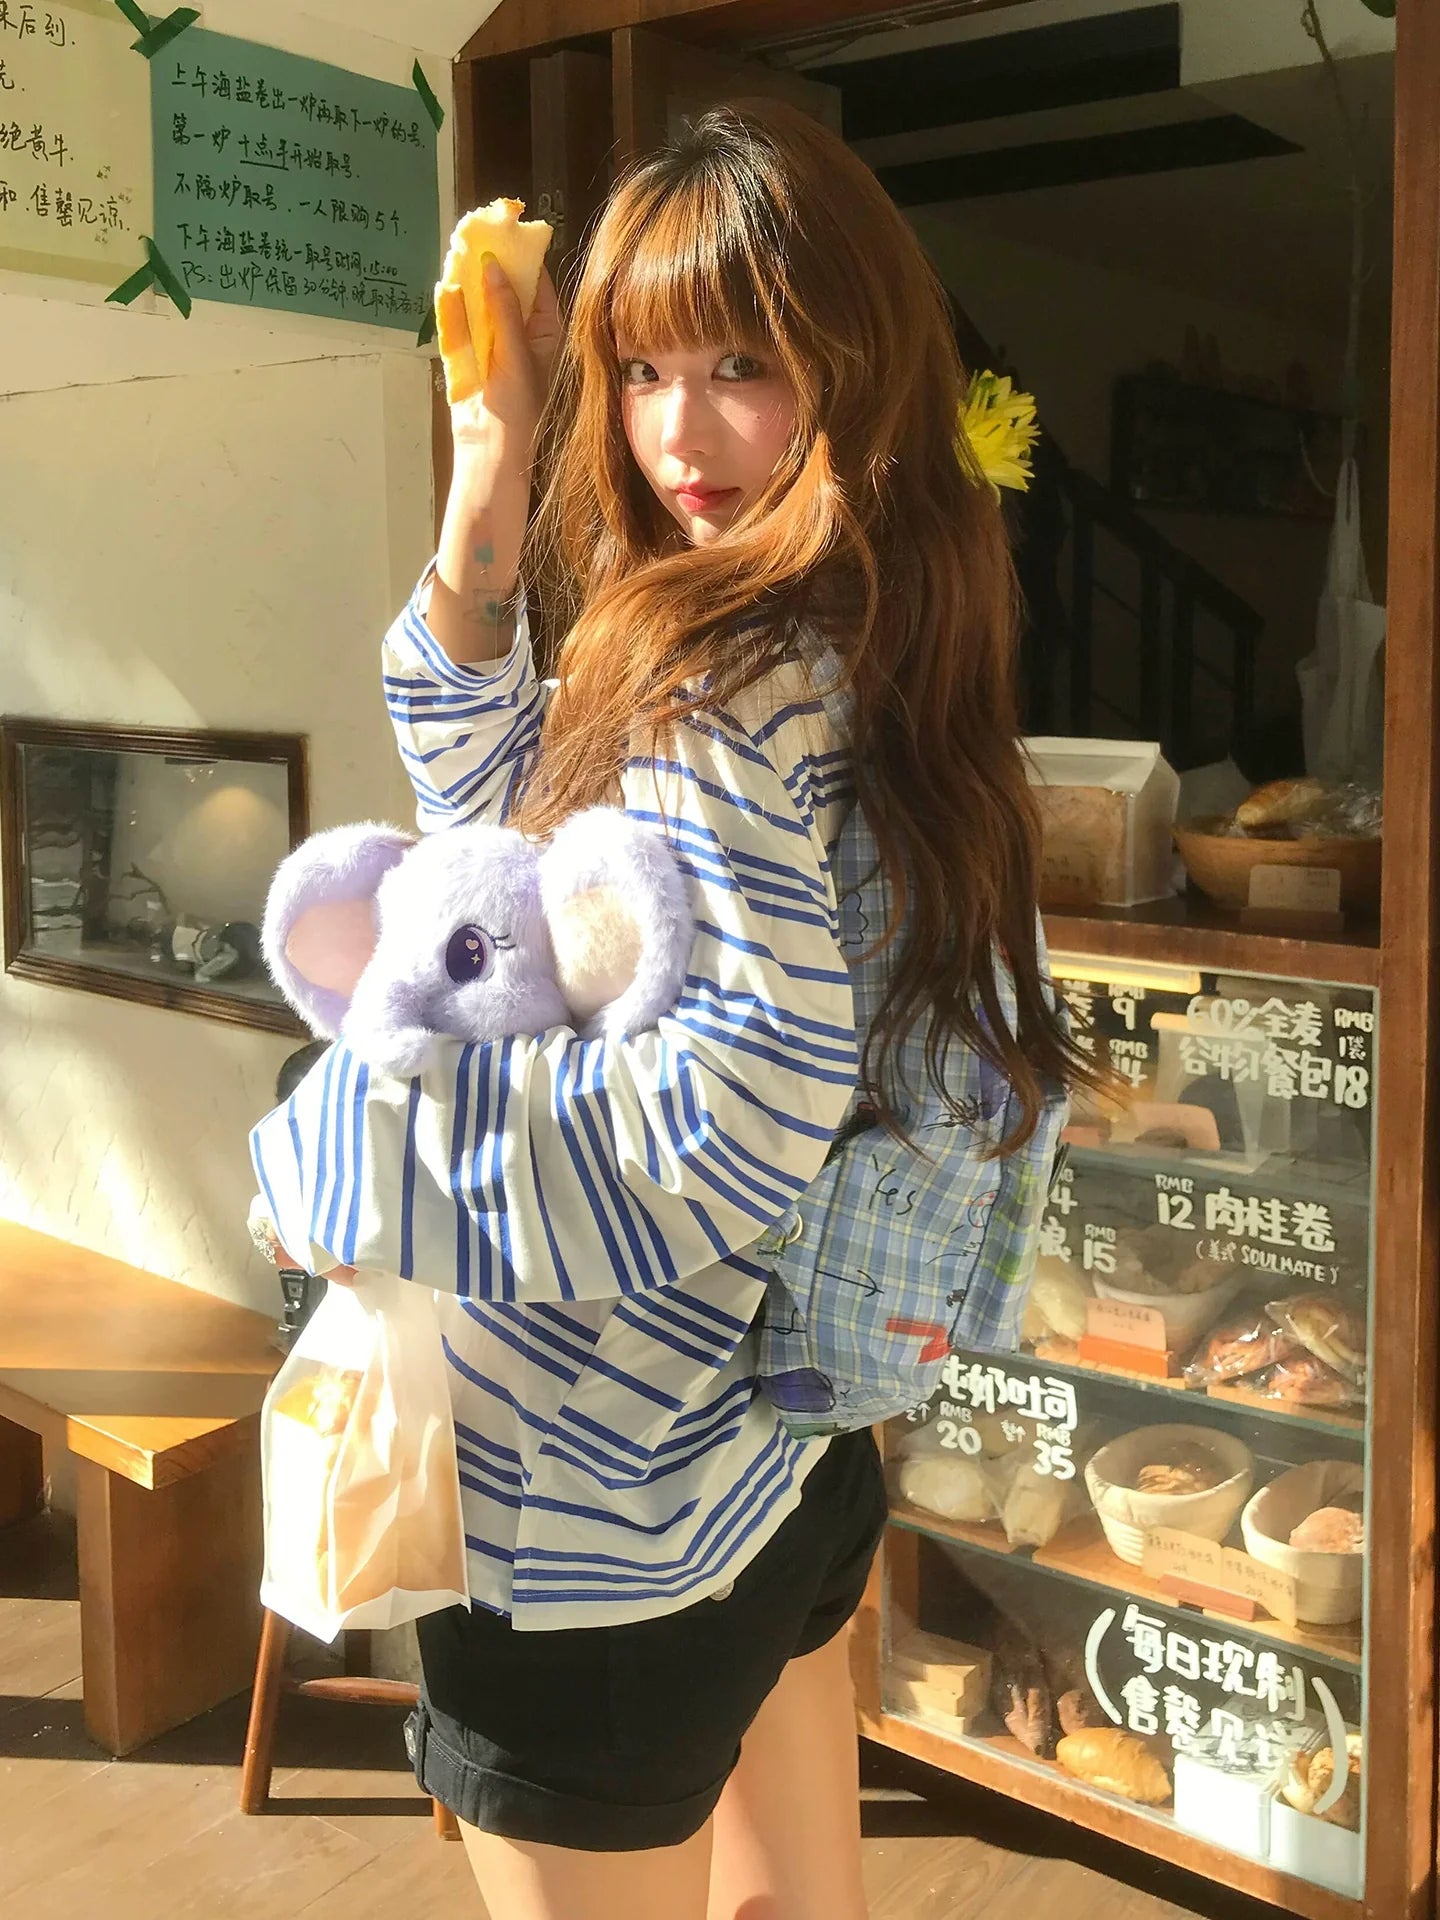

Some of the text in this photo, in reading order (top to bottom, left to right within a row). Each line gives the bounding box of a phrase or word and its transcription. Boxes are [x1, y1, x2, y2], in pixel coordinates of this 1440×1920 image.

[1112, 997, 1136, 1031] 9
[1187, 995, 1323, 1047] 60%全麦
[1334, 1007, 1374, 1032] RMB
[1109, 1038, 1148, 1059] RMB
[1178, 1036, 1333, 1100] 谷物餐包
[1334, 1064, 1369, 1109] 18
[1155, 1174, 1194, 1194] RMB
[1085, 1223, 1117, 1243] RMB
[1157, 1186, 1336, 1253] 12 肉桂卷
[1083, 1238, 1118, 1273] 15
[939, 1401, 972, 1423] RMB
[936, 1420, 982, 1455] 20
[1036, 1423, 1071, 1447] RMB
[1032, 1440, 1076, 1480] 35
